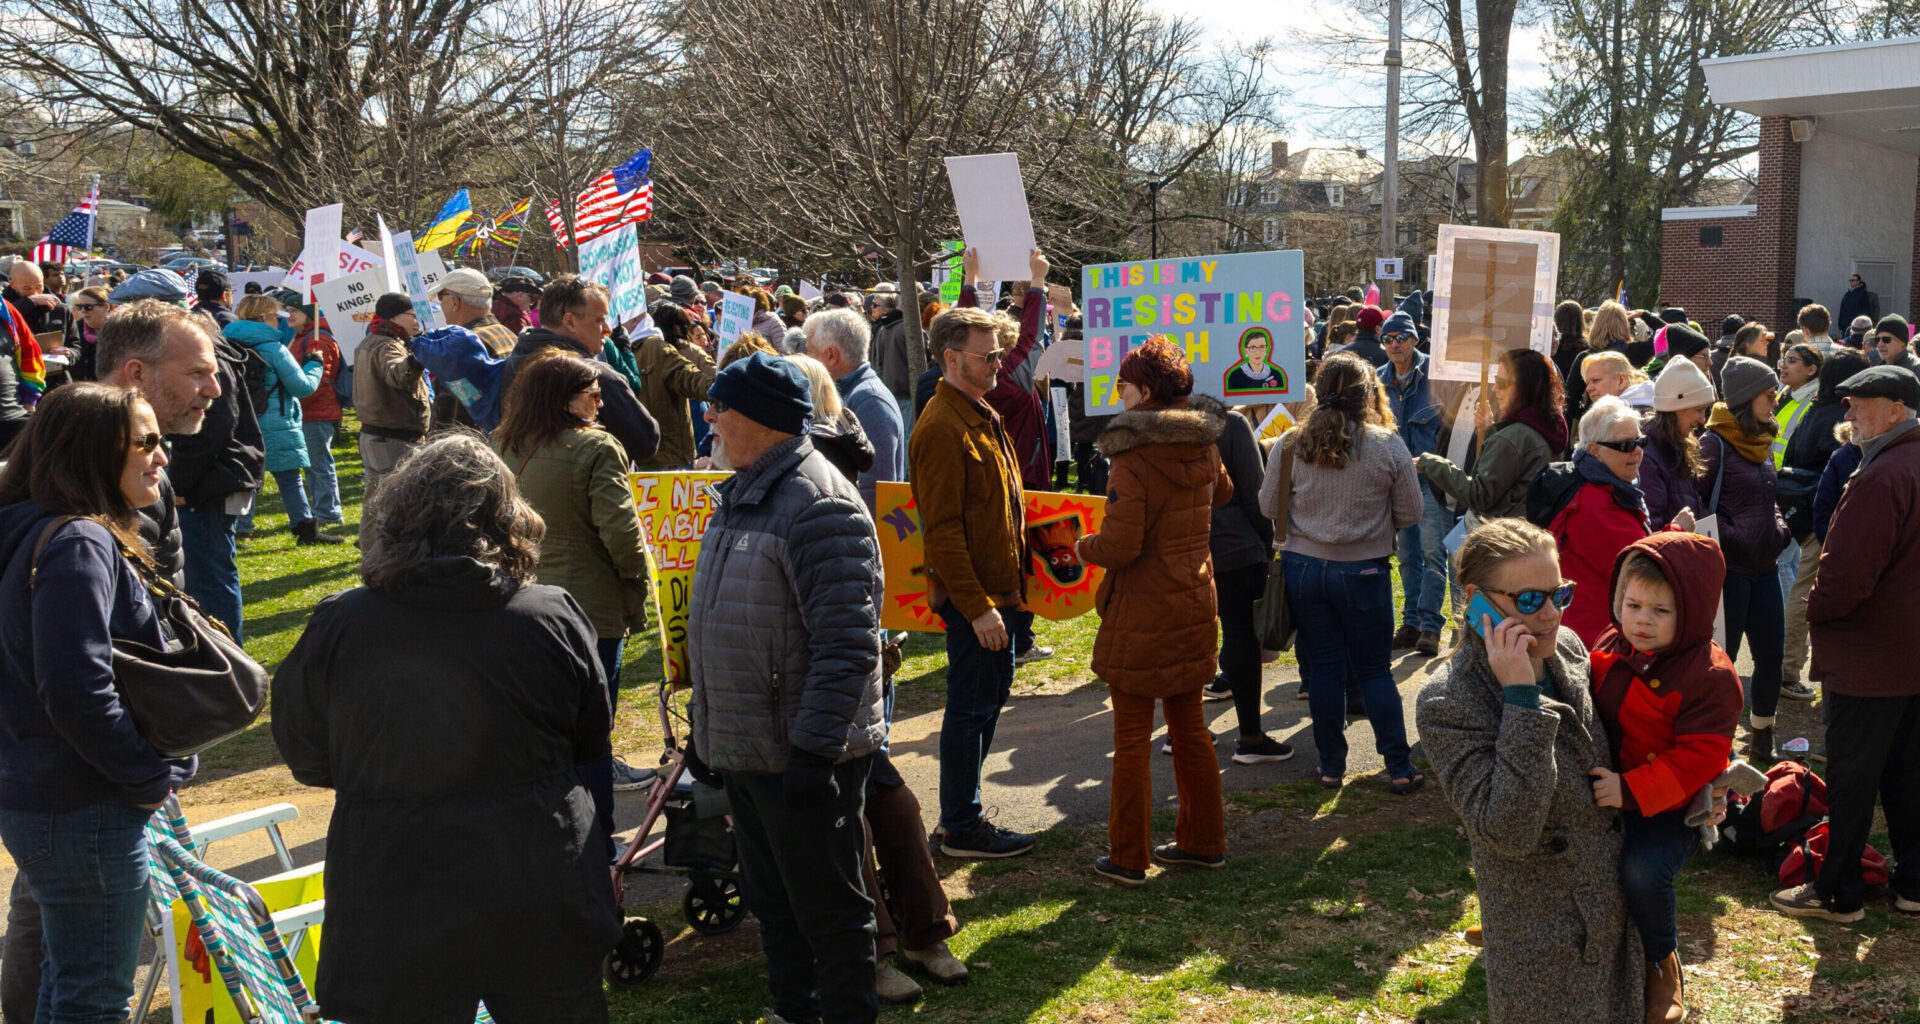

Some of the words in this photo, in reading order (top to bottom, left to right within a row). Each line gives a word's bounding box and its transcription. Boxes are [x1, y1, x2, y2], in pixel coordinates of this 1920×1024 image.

[347, 281, 365, 294] NO
[612, 258, 635, 288] NOT
[1088, 265, 1145, 289] THIS
[1153, 263, 1177, 286] IS
[1181, 260, 1218, 284] MY
[336, 293, 376, 312] KINGS!
[606, 284, 645, 321] AKNESS
[1088, 291, 1293, 329] RESISTING
[1089, 330, 1210, 370] BIH
[637, 476, 660, 512] I
[671, 475, 724, 512] NEE
